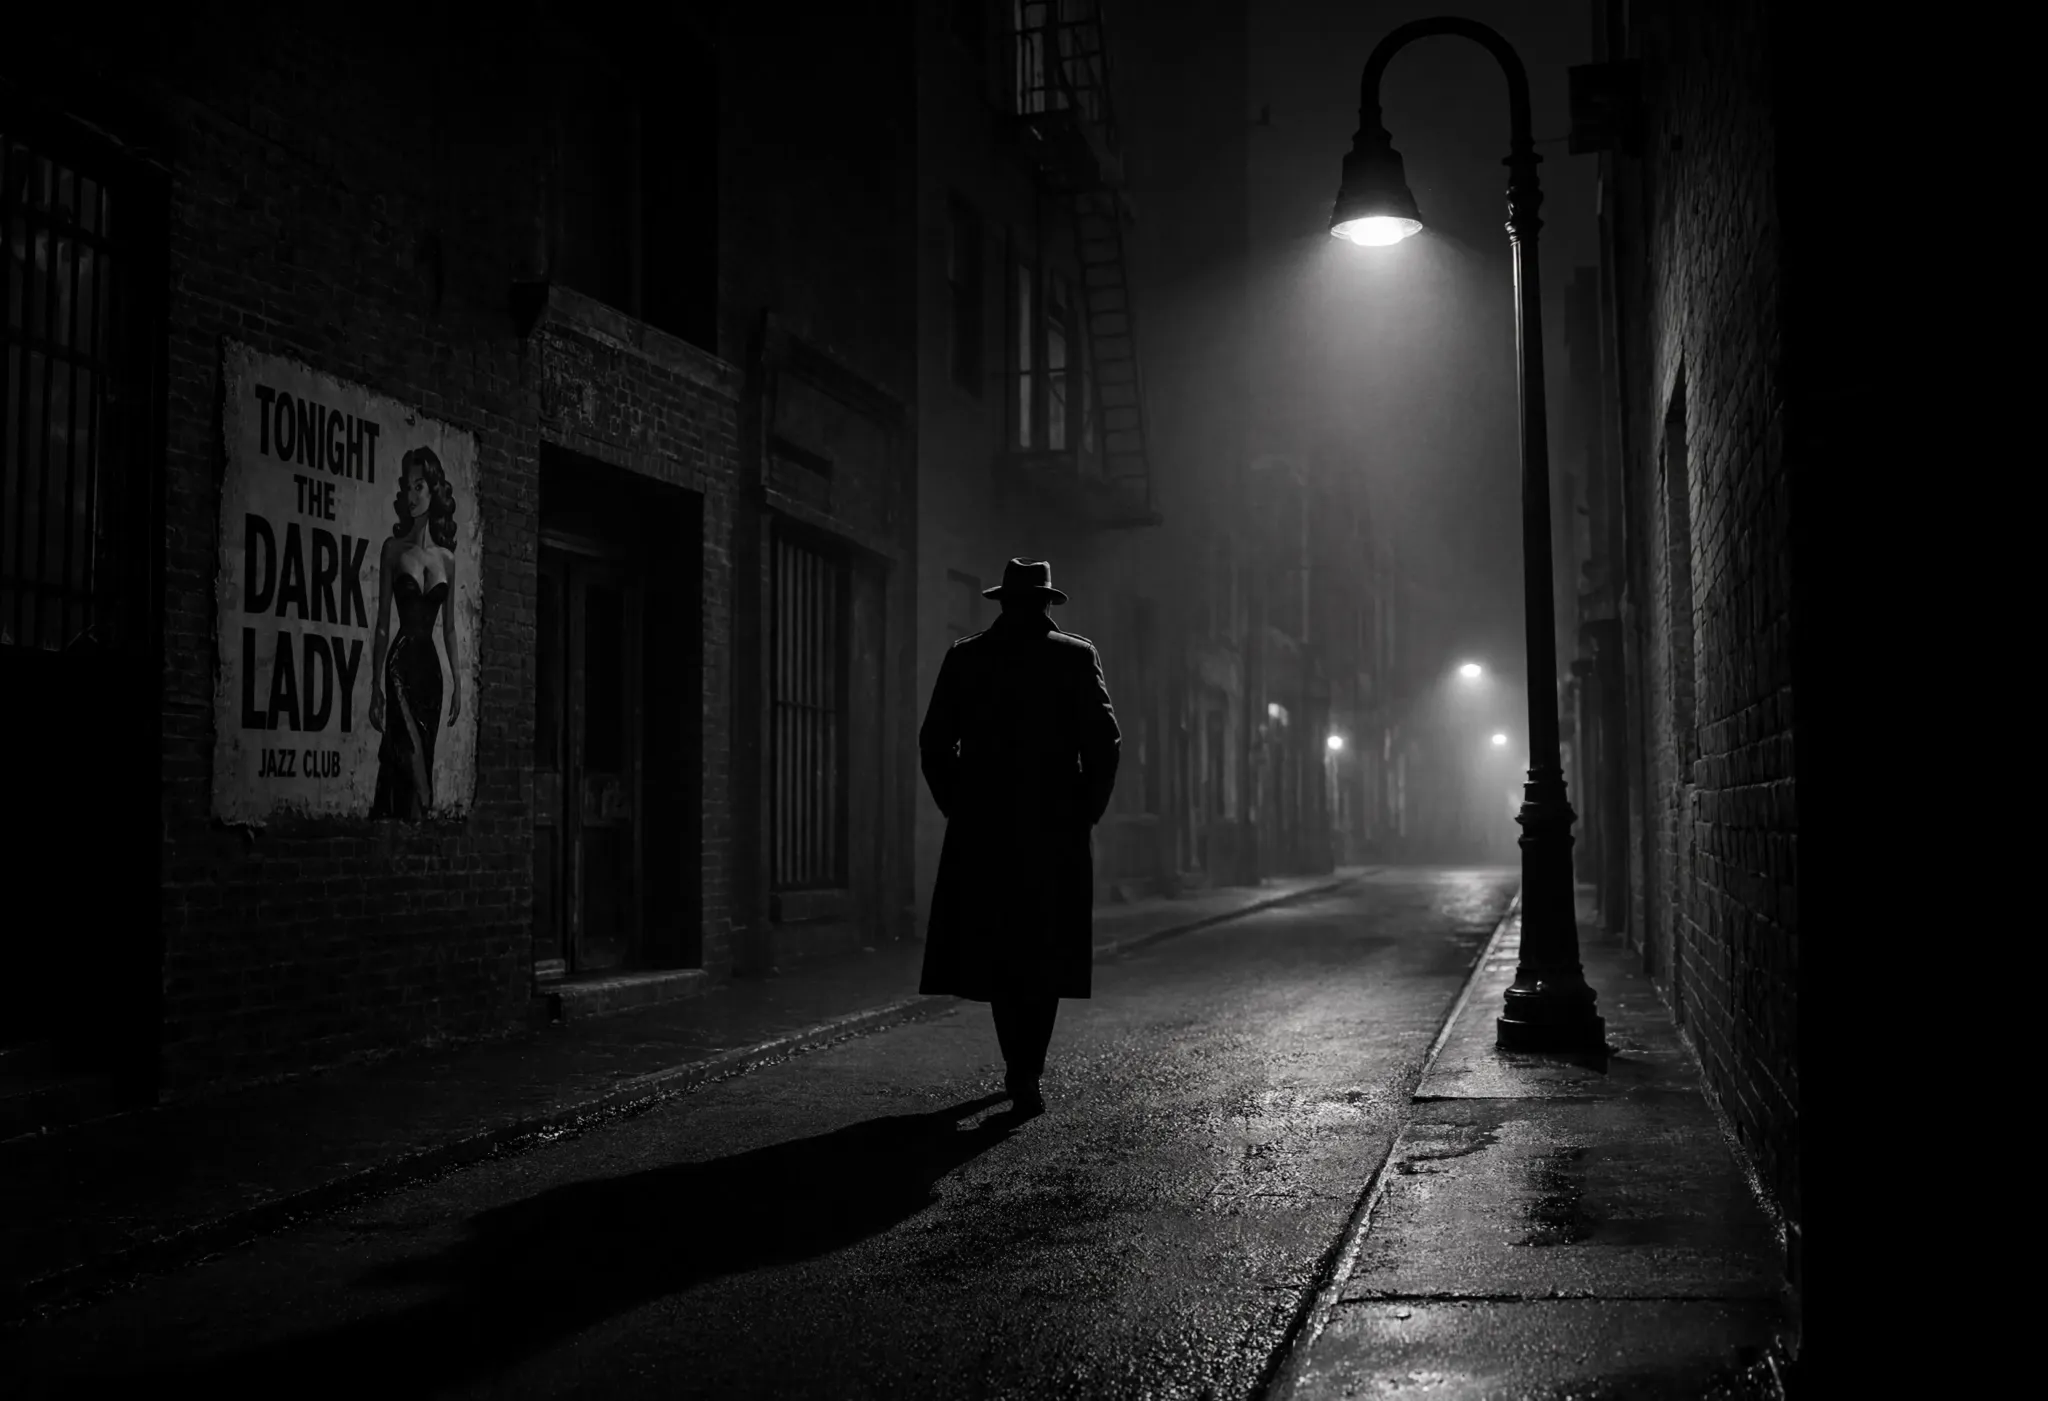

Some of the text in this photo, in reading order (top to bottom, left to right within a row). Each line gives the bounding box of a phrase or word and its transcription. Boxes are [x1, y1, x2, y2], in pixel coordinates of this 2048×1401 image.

[255, 384, 380, 484] TONIGHT
[294, 474, 337, 521] THE
[244, 512, 369, 628] DARK
[241, 627, 364, 734] LADY
[258, 749, 341, 779] JAZZ CLUB
